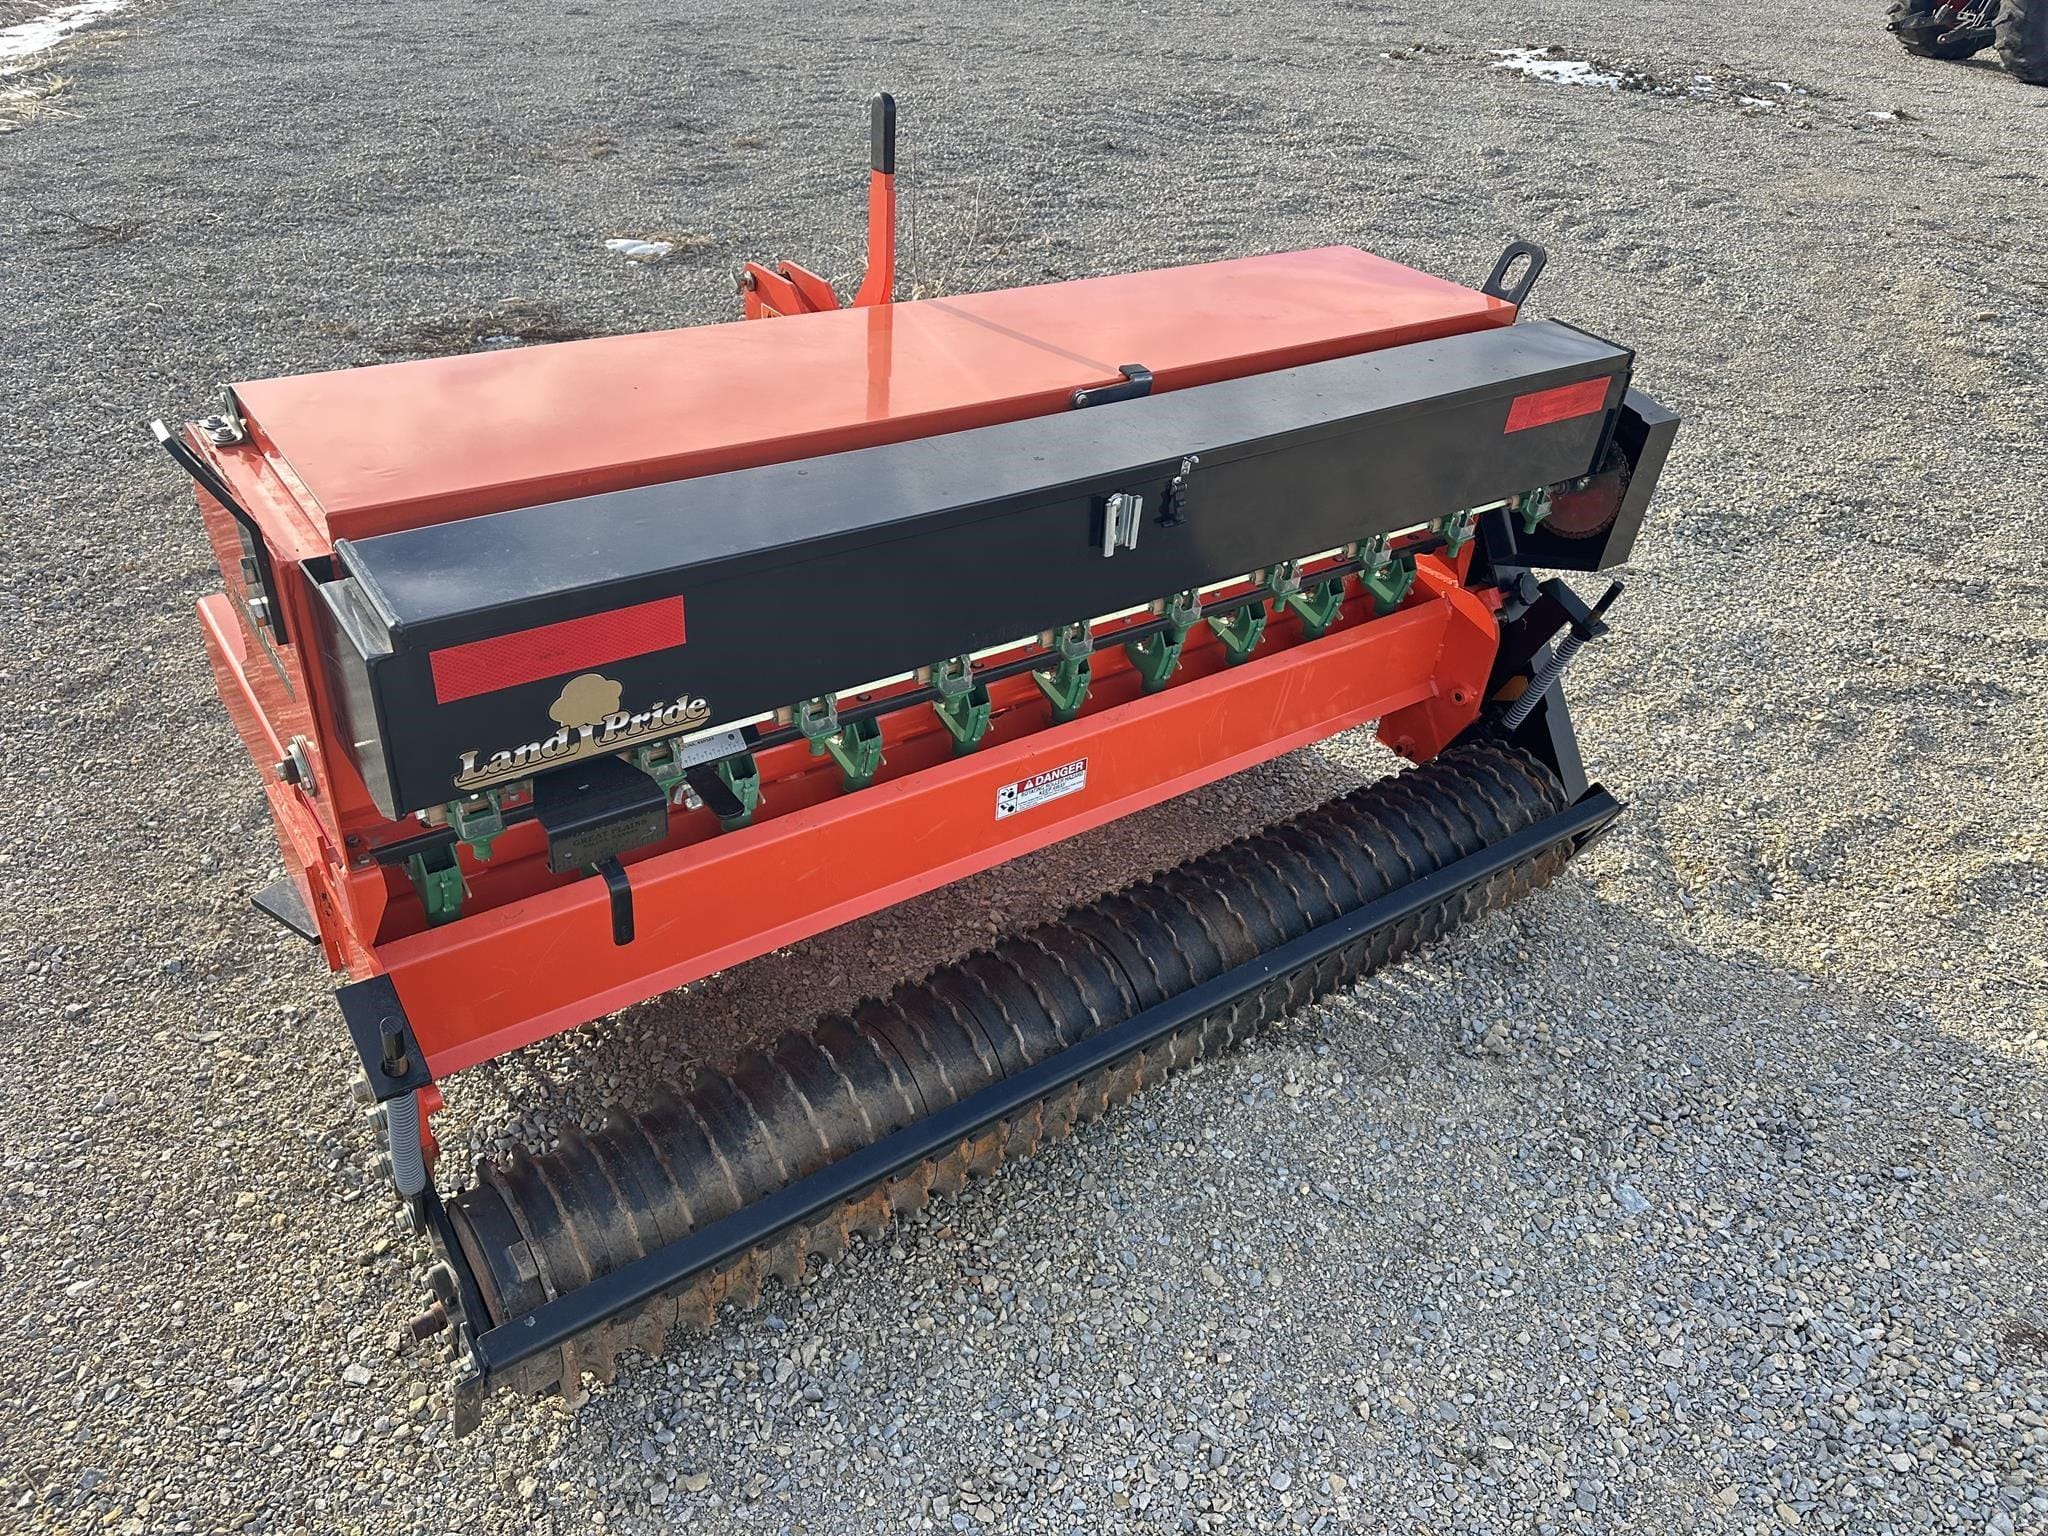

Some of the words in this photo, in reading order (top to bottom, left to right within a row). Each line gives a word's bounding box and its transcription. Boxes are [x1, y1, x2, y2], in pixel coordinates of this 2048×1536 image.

[458, 727, 571, 783] Land
[600, 694, 708, 742] Pride
[1035, 761, 1084, 785] DANGER
